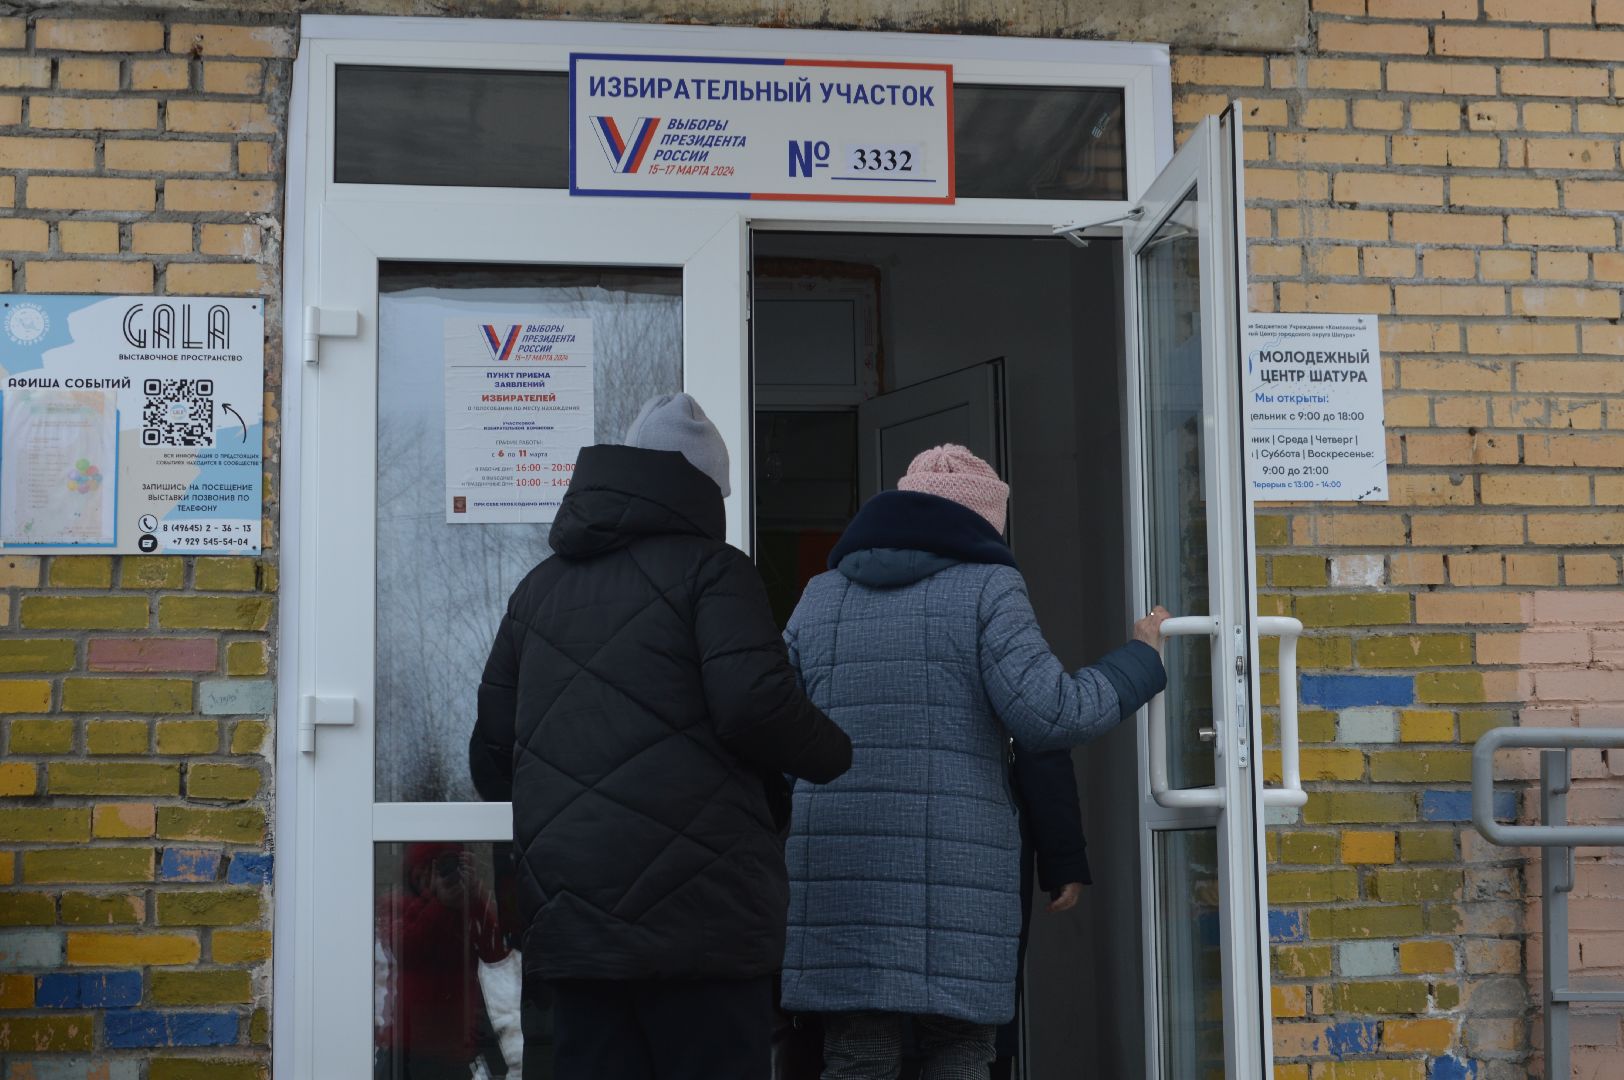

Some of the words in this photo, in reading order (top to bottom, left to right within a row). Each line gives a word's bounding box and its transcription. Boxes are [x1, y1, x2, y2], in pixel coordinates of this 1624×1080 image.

[589, 76, 811, 103] ИЗБИРАТЕЛЬНЫЙ
[820, 82, 934, 107] УЧАСТОК
[667, 118, 729, 131] ВЫБОРЫ
[660, 134, 747, 147] ПРЕЗИДЕНТА
[653, 150, 709, 162] РОССИИ
[788, 140, 830, 178] №
[853, 148, 912, 171] 3332
[677, 165, 709, 175] МАРТА
[711, 166, 735, 176] 2024
[123, 303, 230, 349] GALA
[526, 324, 564, 333] ВЫБОРЫ
[521, 335, 576, 343] ПРЕЗИДЕНТА
[518, 345, 552, 353] РОССИИ
[181, 354, 242, 362] ПРОСТРАНСТВО
[1260, 349, 1370, 365] МОЛОДЕЖНЫЙ
[1260, 370, 1305, 383] ЦЕНТР
[1309, 370, 1368, 382] ШАТУРА
[8, 378, 60, 388] АФИША
[65, 376, 131, 389] СОБЫТИЙ
[481, 393, 556, 402] ИЗБИРАТЕЛЕЙ
[1255, 393, 1274, 403] Мы
[1277, 394, 1329, 405] открыты:
[1298, 412, 1321, 421] 9:00
[1323, 413, 1335, 421] до
[1338, 412, 1364, 421] 18:00
[1277, 435, 1308, 445] Среда
[1315, 435, 1353, 445] Четверг
[497, 450, 505, 458] 6
[1261, 449, 1301, 460] Суббота
[1308, 450, 1374, 460] Воскресенье:
[516, 464, 541, 472] 16:00
[551, 464, 576, 472] 20:00
[1262, 466, 1285, 475] 9:00
[1287, 468, 1300, 476] до
[1303, 466, 1329, 475] 21:00
[142, 483, 187, 491] ЗАПИШИСЬ
[202, 484, 253, 492] ПОСЕЩЕНИЕ
[516, 479, 541, 487] 10:00
[551, 479, 571, 487] 14:0
[171, 524, 202, 532] (49645)
[185, 538, 200, 546] 929
[203, 538, 248, 546] 545-54-04
